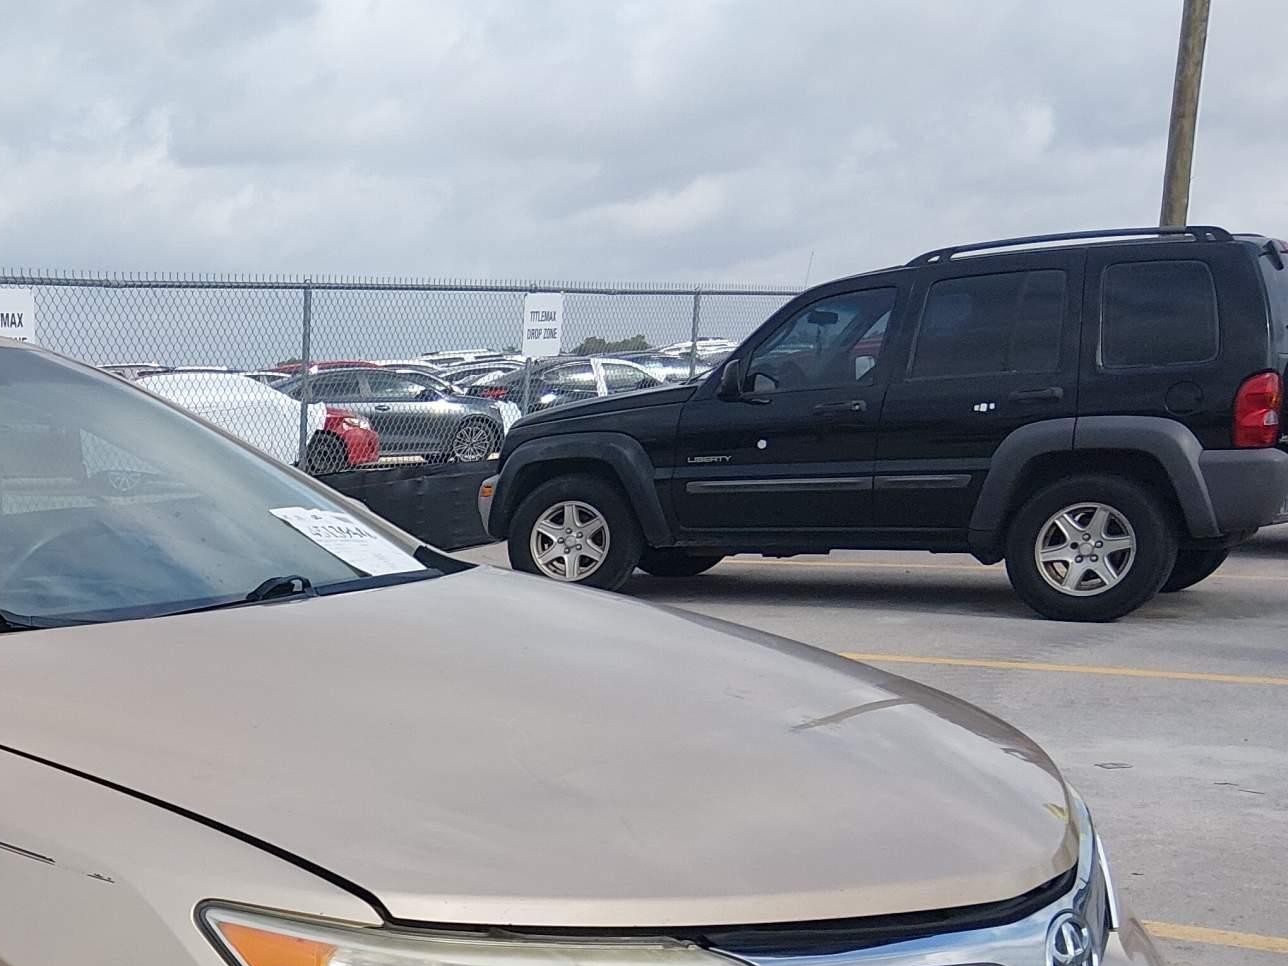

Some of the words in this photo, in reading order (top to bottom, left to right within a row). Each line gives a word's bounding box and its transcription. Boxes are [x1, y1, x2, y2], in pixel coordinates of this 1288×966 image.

[530, 311, 557, 322] TITLEMAX
[527, 329, 542, 340] DROP
[543, 328, 558, 339] ZONE
[687, 455, 732, 463] LIBERTY
